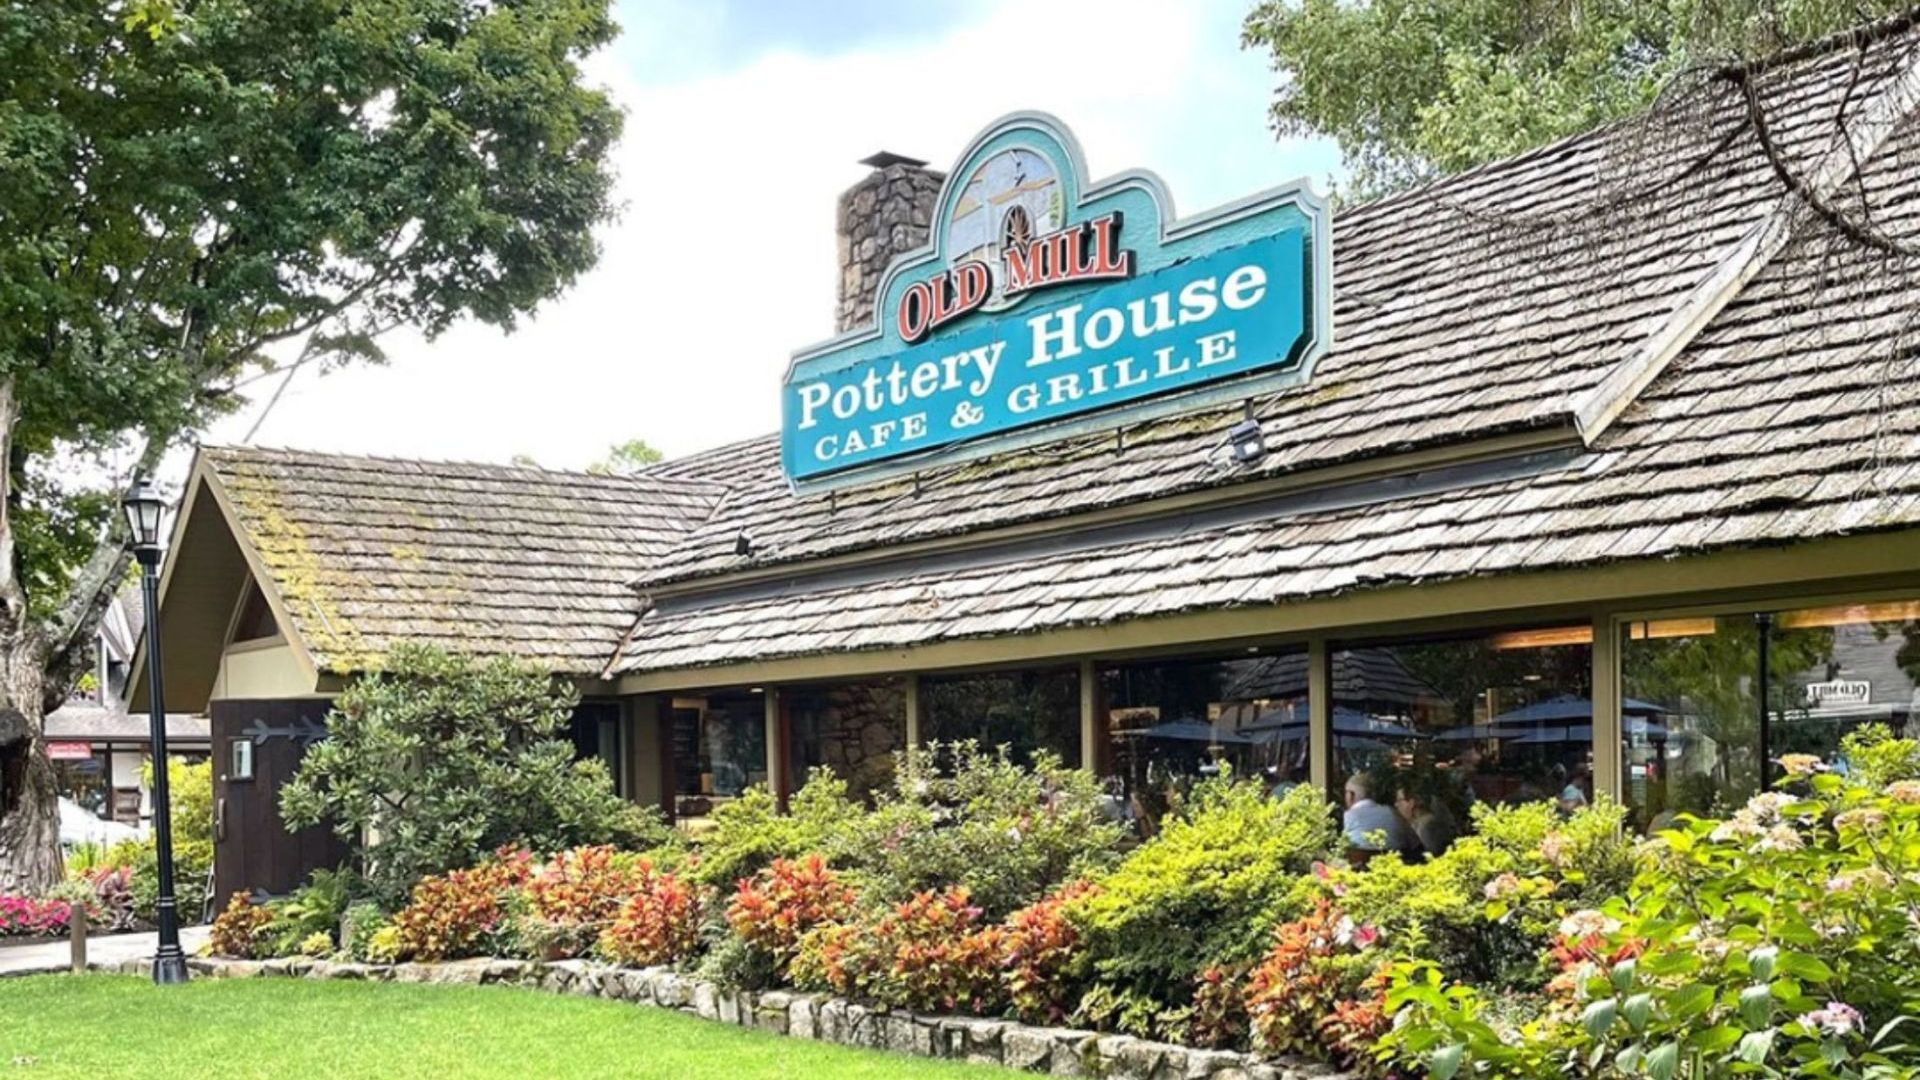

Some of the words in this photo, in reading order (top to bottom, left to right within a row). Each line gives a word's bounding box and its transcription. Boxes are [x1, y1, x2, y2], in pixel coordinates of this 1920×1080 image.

[897, 263, 987, 341] OLD
[1004, 214, 1128, 291] MILL
[797, 340, 1006, 430] Pottery
[1026, 263, 1268, 367] House
[814, 413, 927, 461] CAFE
[950, 401, 984, 428] &
[1007, 329, 1236, 414] GRILLE
